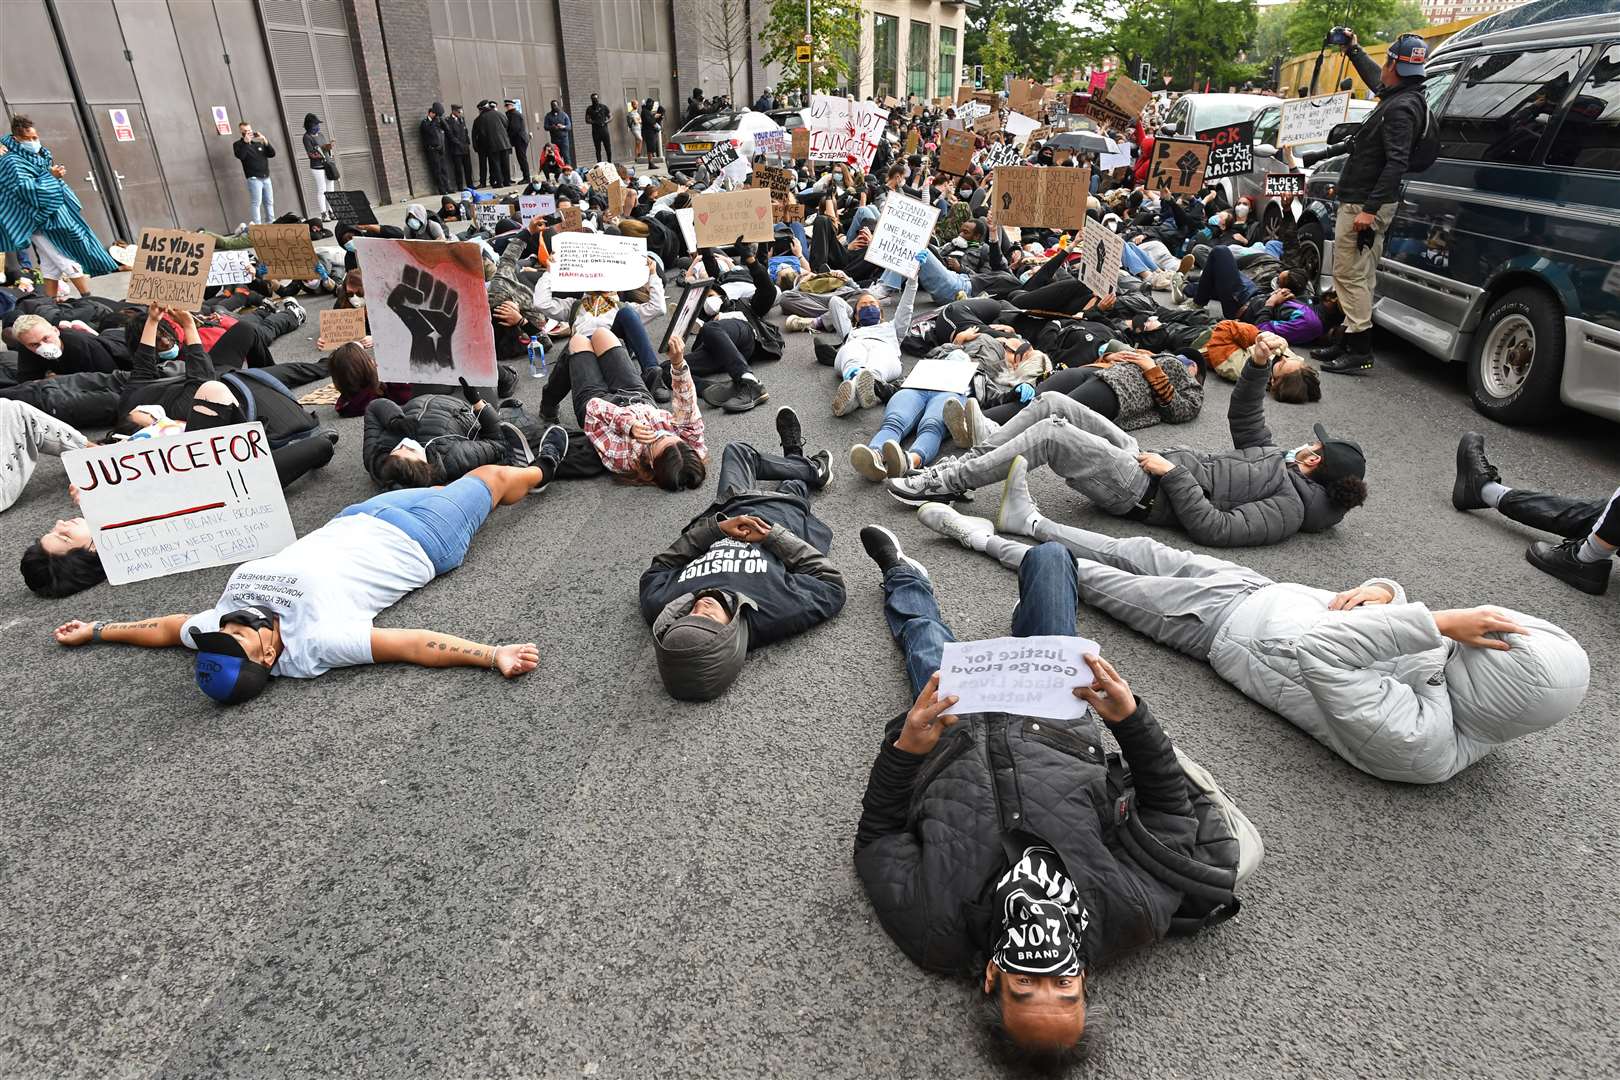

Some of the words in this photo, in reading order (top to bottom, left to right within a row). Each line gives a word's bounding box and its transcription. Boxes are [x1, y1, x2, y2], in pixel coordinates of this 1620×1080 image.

[857, 111, 889, 130] NOT
[754, 131, 768, 139] YOUR
[1205, 160, 1251, 178] RACISM
[888, 206, 928, 228] TOGETHER
[897, 201, 926, 217] STAND
[141, 232, 165, 252] LAS
[252, 228, 309, 250] BLACK
[884, 223, 899, 235] ONE
[901, 230, 920, 243] RACE
[891, 236, 905, 246] THE
[260, 248, 309, 261] LIVES
[879, 239, 916, 261] HUMAN
[146, 255, 199, 277] NEGRAS
[268, 260, 314, 274] MATTER
[883, 254, 902, 267] RACE
[80, 441, 209, 491] JUSTICE
[210, 429, 268, 466] FOR
[114, 523, 157, 547] LEFT
[164, 520, 179, 536] IT
[183, 510, 226, 533] BLANK
[233, 503, 274, 521] BECAUSE
[133, 539, 181, 560] PROBABLY
[185, 531, 215, 548] NEED
[218, 527, 241, 540] THIS
[244, 519, 271, 534] SIGN
[126, 561, 152, 576] AGAIN
[160, 548, 201, 569] NEXT
[739, 548, 760, 559] NO
[744, 558, 768, 573] NO
[285, 575, 298, 584] BS
[255, 592, 275, 603] YOUR
[275, 595, 292, 609] TAKE
[1003, 917, 1062, 949] NO.7
[1017, 949, 1060, 960] BRAND
